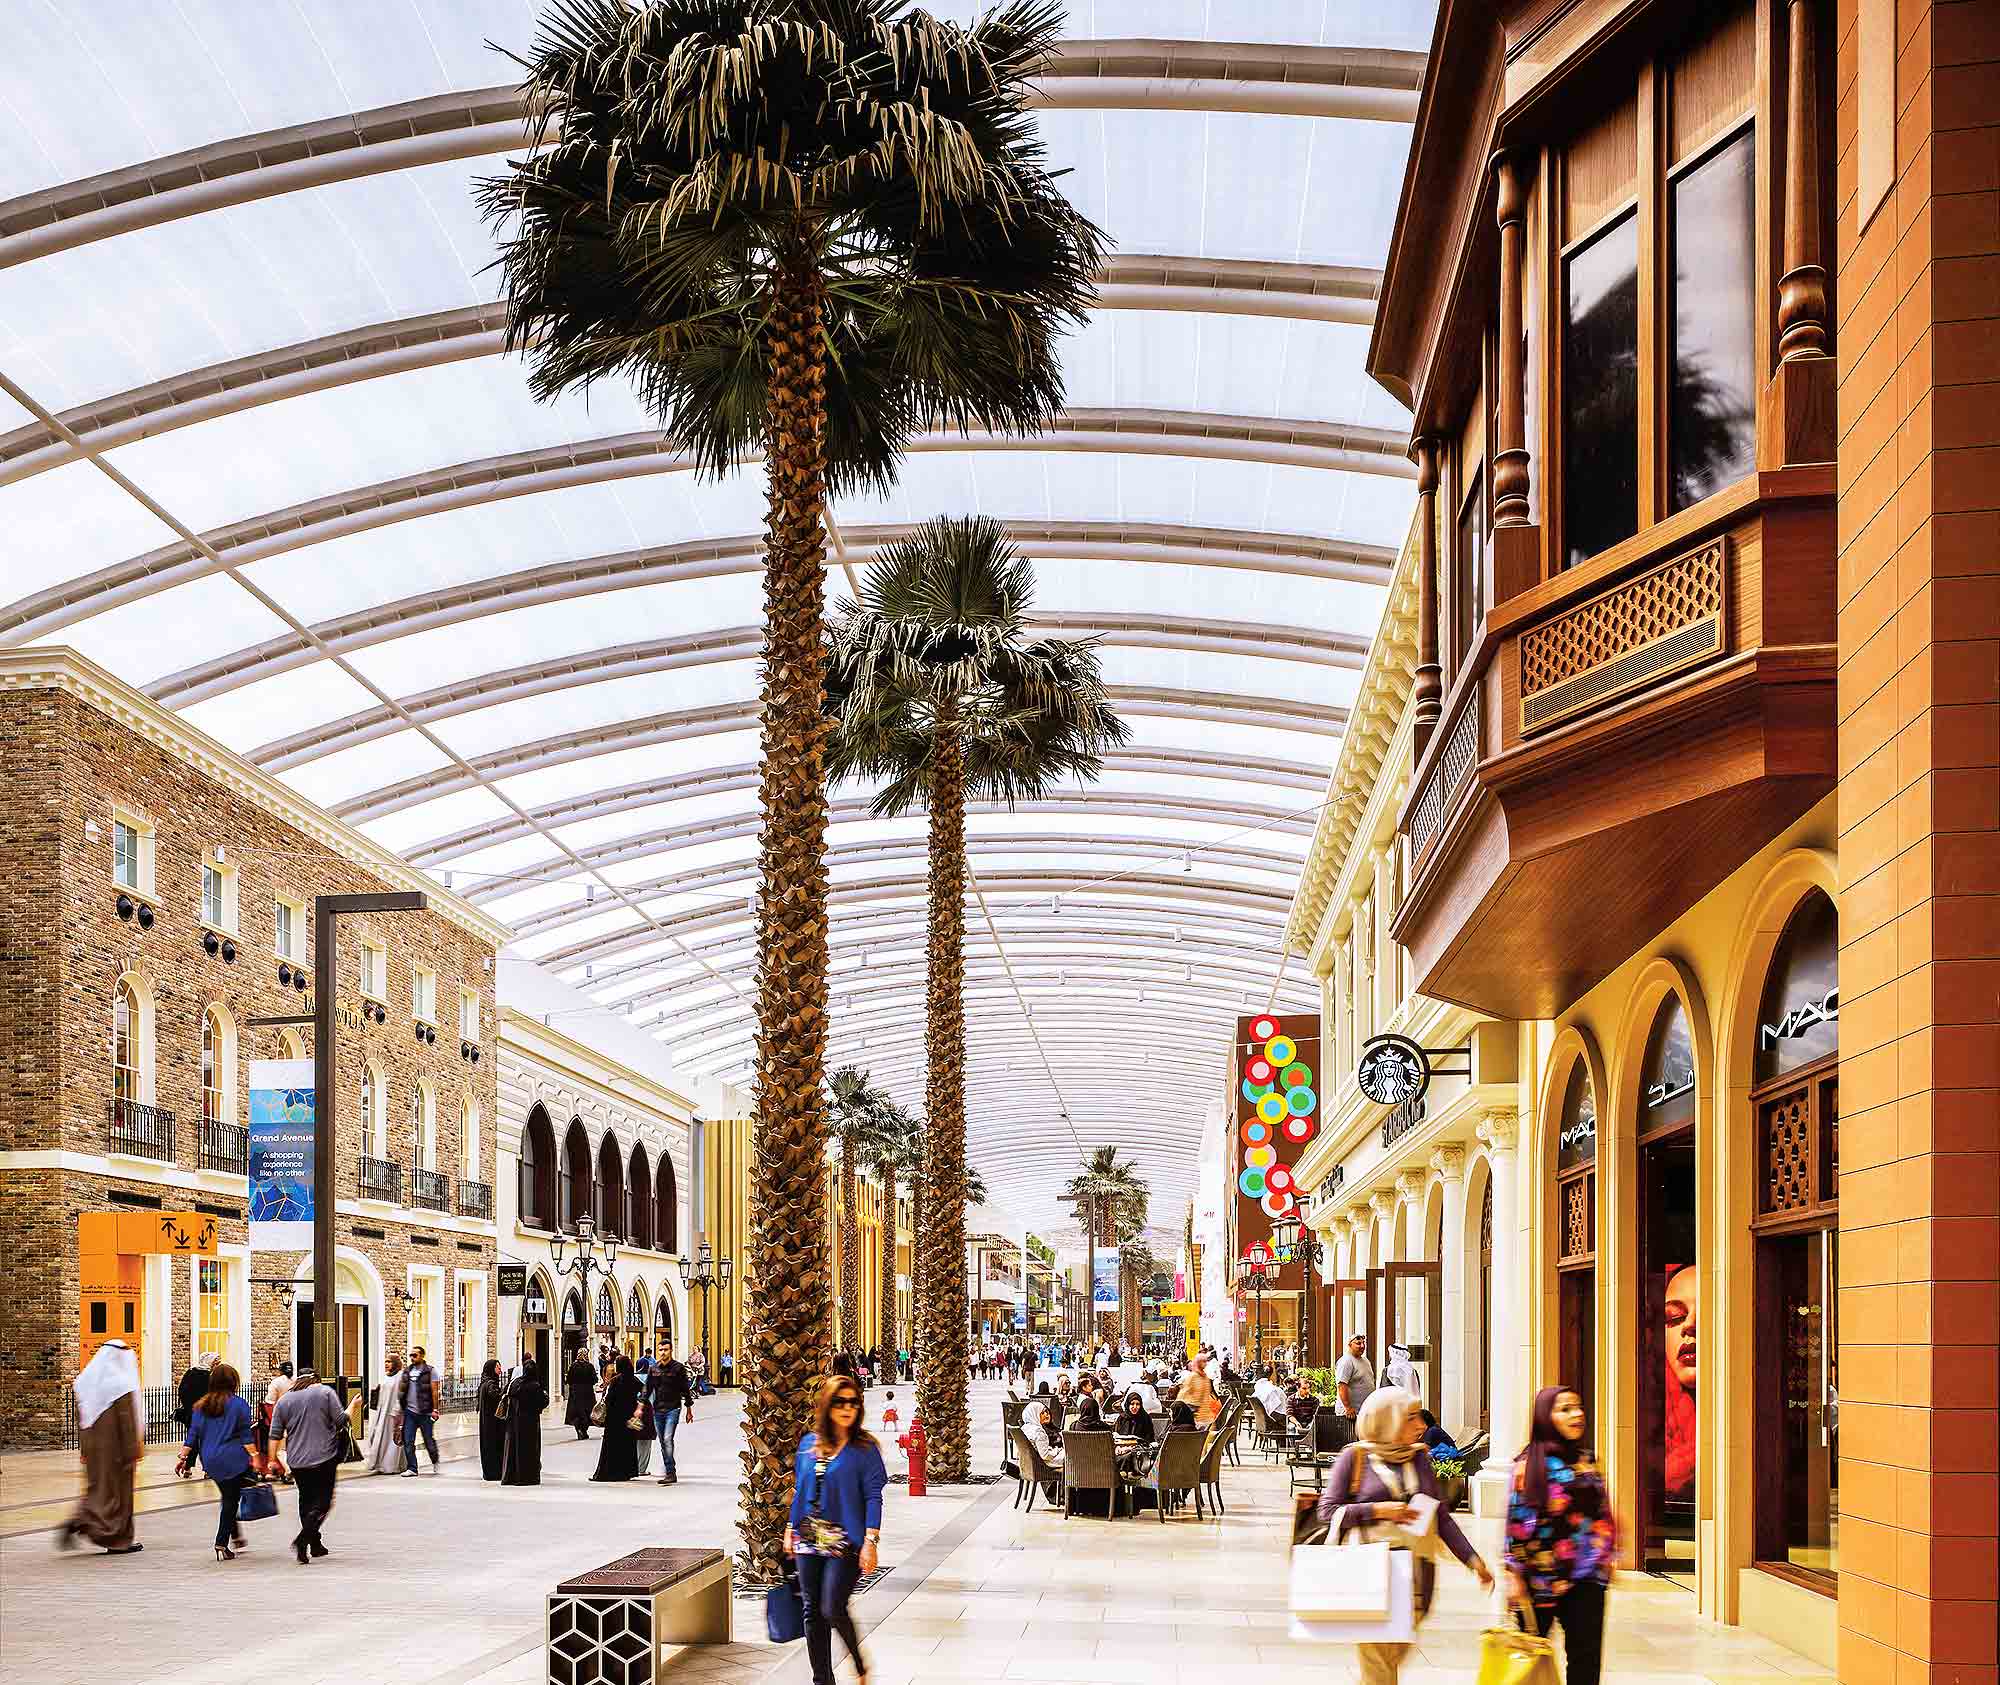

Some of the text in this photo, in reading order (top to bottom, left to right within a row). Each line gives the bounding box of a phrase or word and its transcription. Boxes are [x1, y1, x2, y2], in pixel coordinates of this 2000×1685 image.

[251, 1134, 314, 1142] Grand Avenue
[262, 1151, 304, 1160] A shopping
[262, 1160, 303, 1169] experience
[259, 1169, 272, 1177] like
[285, 1169, 306, 1177] other
